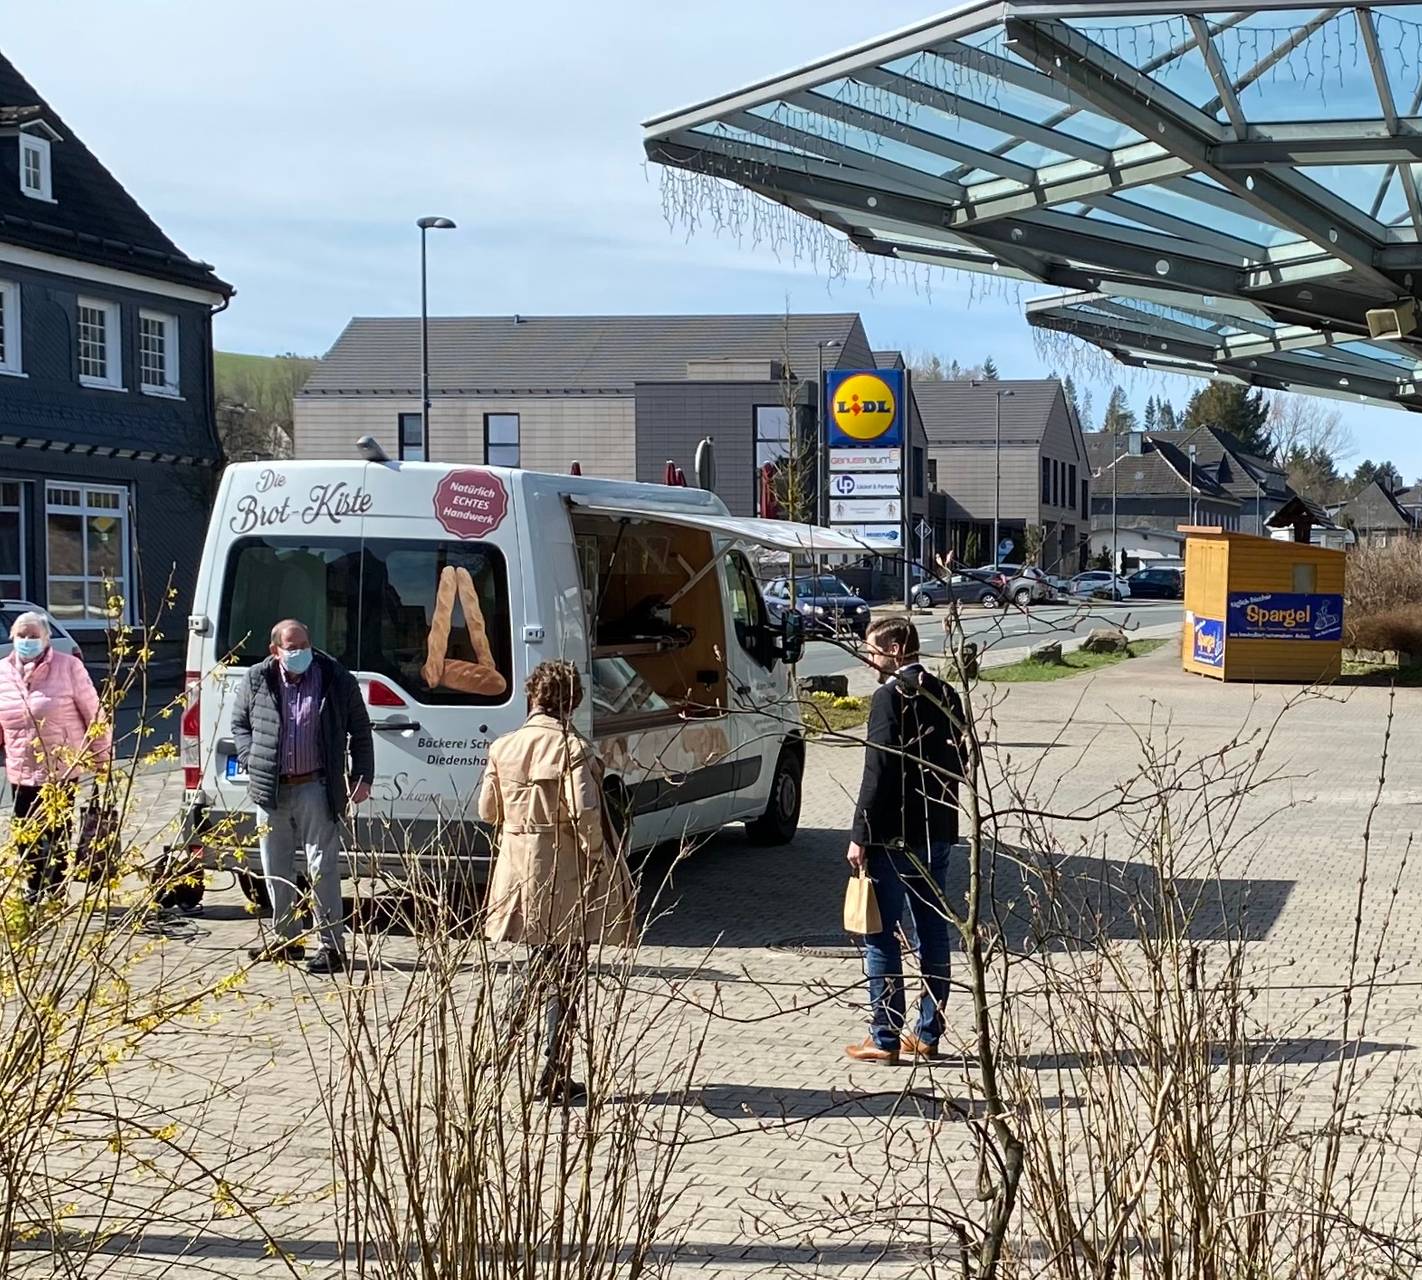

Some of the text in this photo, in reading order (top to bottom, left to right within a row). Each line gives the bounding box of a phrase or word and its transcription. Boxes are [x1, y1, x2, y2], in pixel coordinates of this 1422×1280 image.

[256, 469, 286, 493] Die
[449, 481, 496, 499] Natürlich
[229, 481, 373, 534] Brot-Kiste
[452, 495, 490, 511] ECHTES
[442, 506, 495, 525] Handwerk
[1246, 604, 1310, 627] Spargel
[418, 737, 467, 749] Bäckerei
[427, 754, 487, 766] Diedensha
